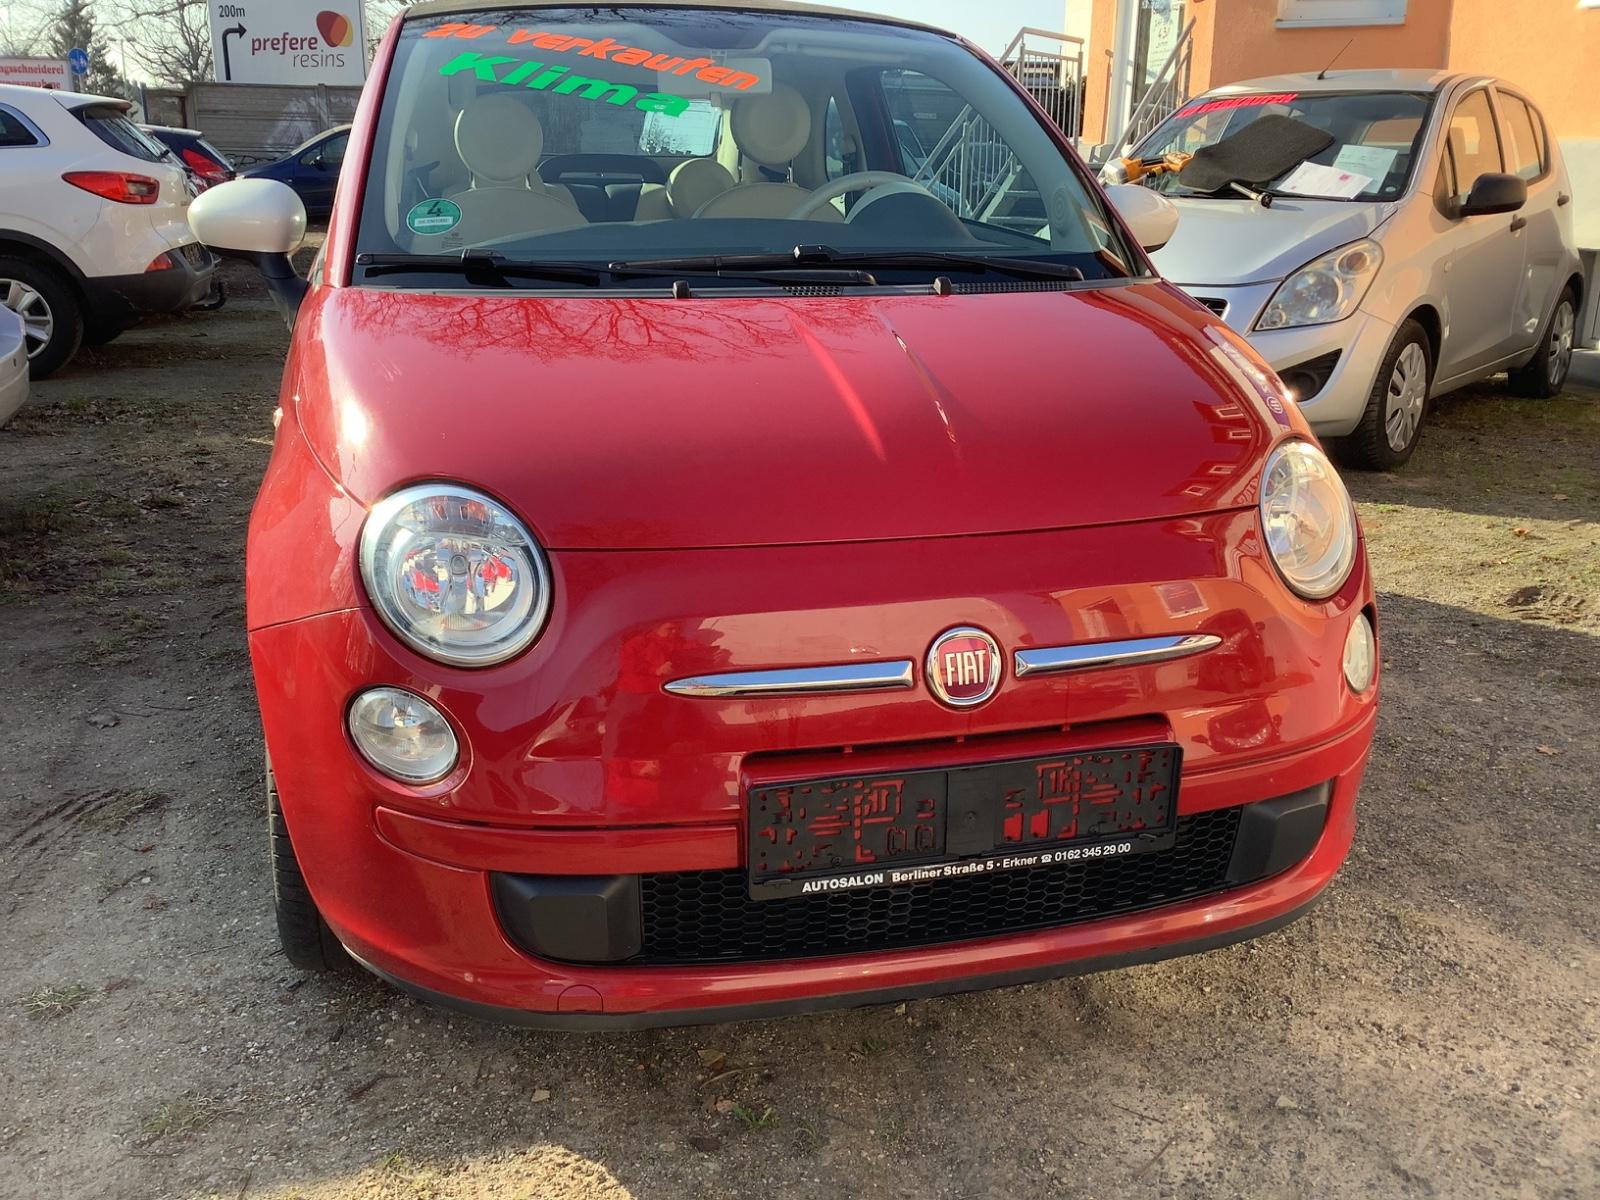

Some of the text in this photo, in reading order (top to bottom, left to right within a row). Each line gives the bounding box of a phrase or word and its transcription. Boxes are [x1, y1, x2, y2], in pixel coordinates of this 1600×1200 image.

[219, 5, 245, 17] 200m
[251, 32, 318, 55] prefere
[293, 49, 345, 68] resins
[507, 28, 759, 90] verkaufen
[438, 52, 690, 118] Klima
[426, 201, 444, 217] 4
[944, 649, 987, 687] FIAT
[802, 842, 1132, 893] AUTOSALON Berliner Straße 5 Erkner 0162 345 29 00
